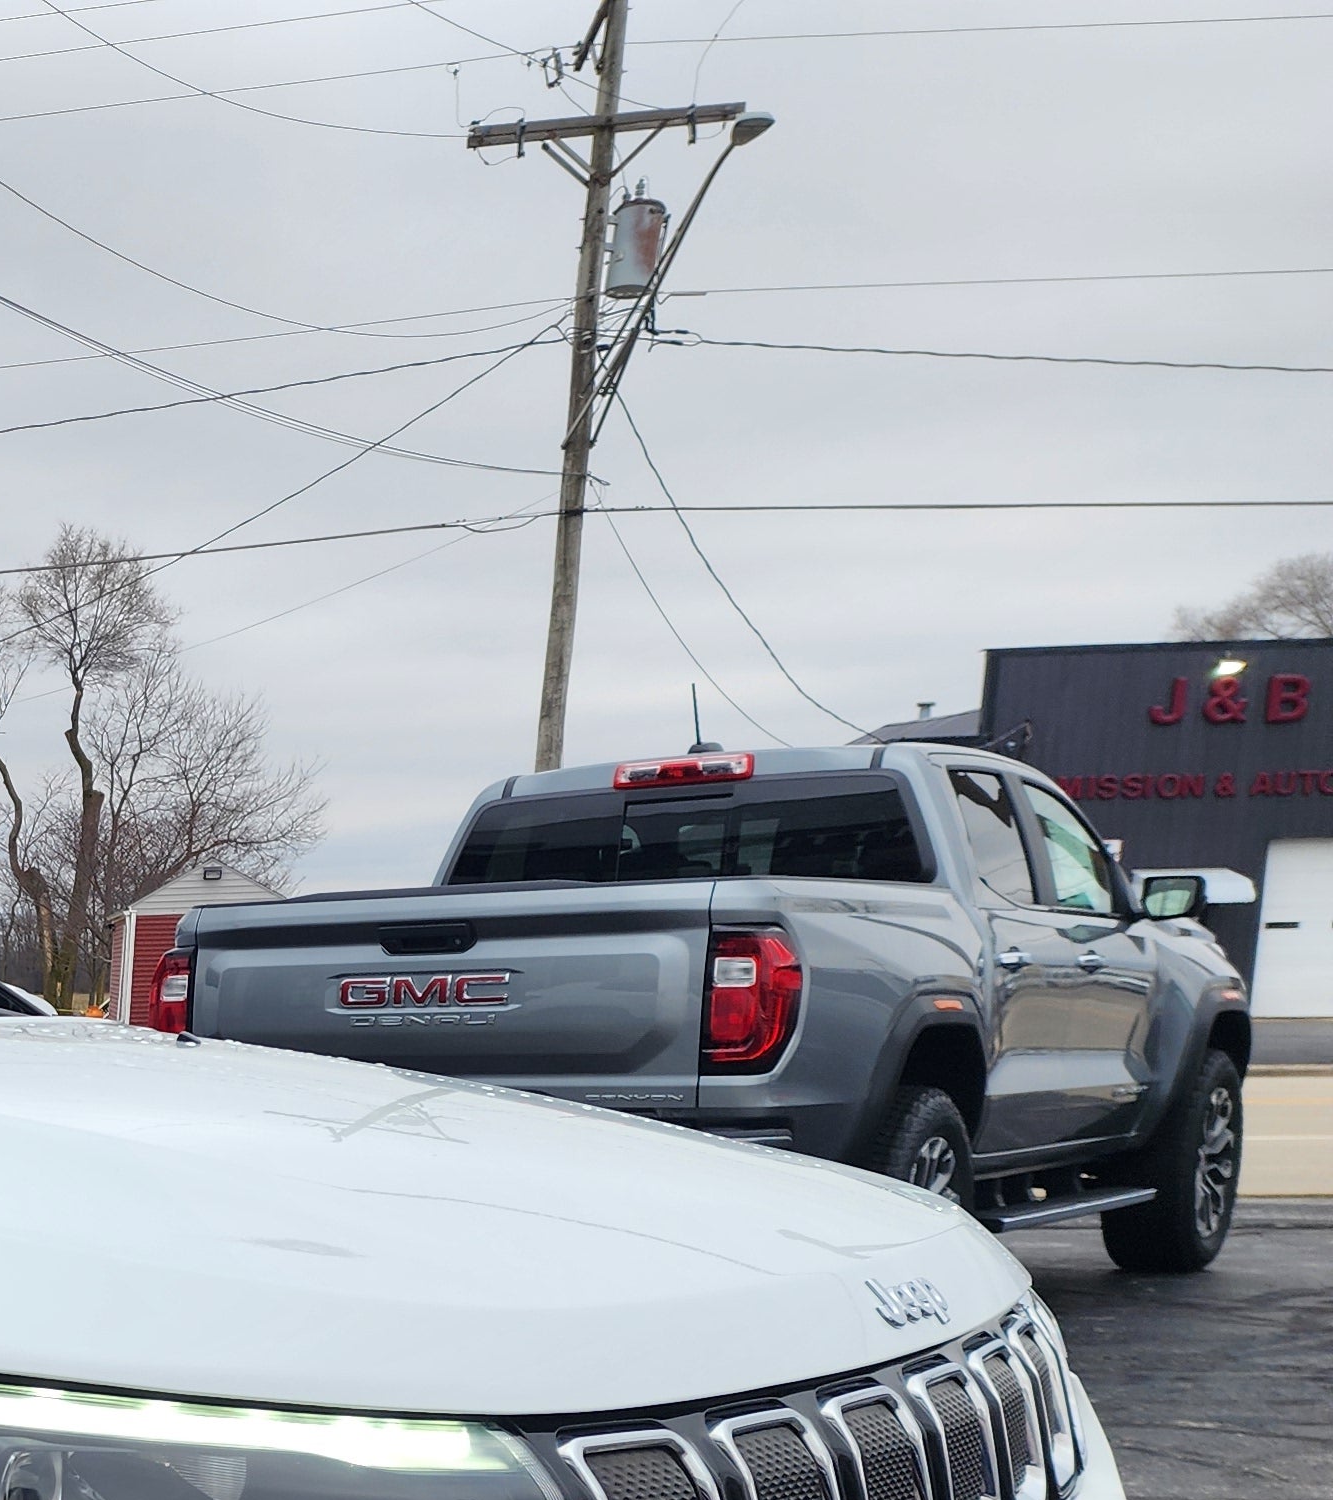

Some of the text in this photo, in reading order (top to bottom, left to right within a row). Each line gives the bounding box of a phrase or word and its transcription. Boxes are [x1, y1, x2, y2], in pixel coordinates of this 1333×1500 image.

[1147, 674, 1312, 726] J & B
[1059, 773, 1206, 800] MISSION
[1214, 771, 1236, 799] &
[339, 972, 510, 1009] GMC
[349, 1013, 497, 1028] DENALI
[864, 1277, 951, 1329] Jeep
